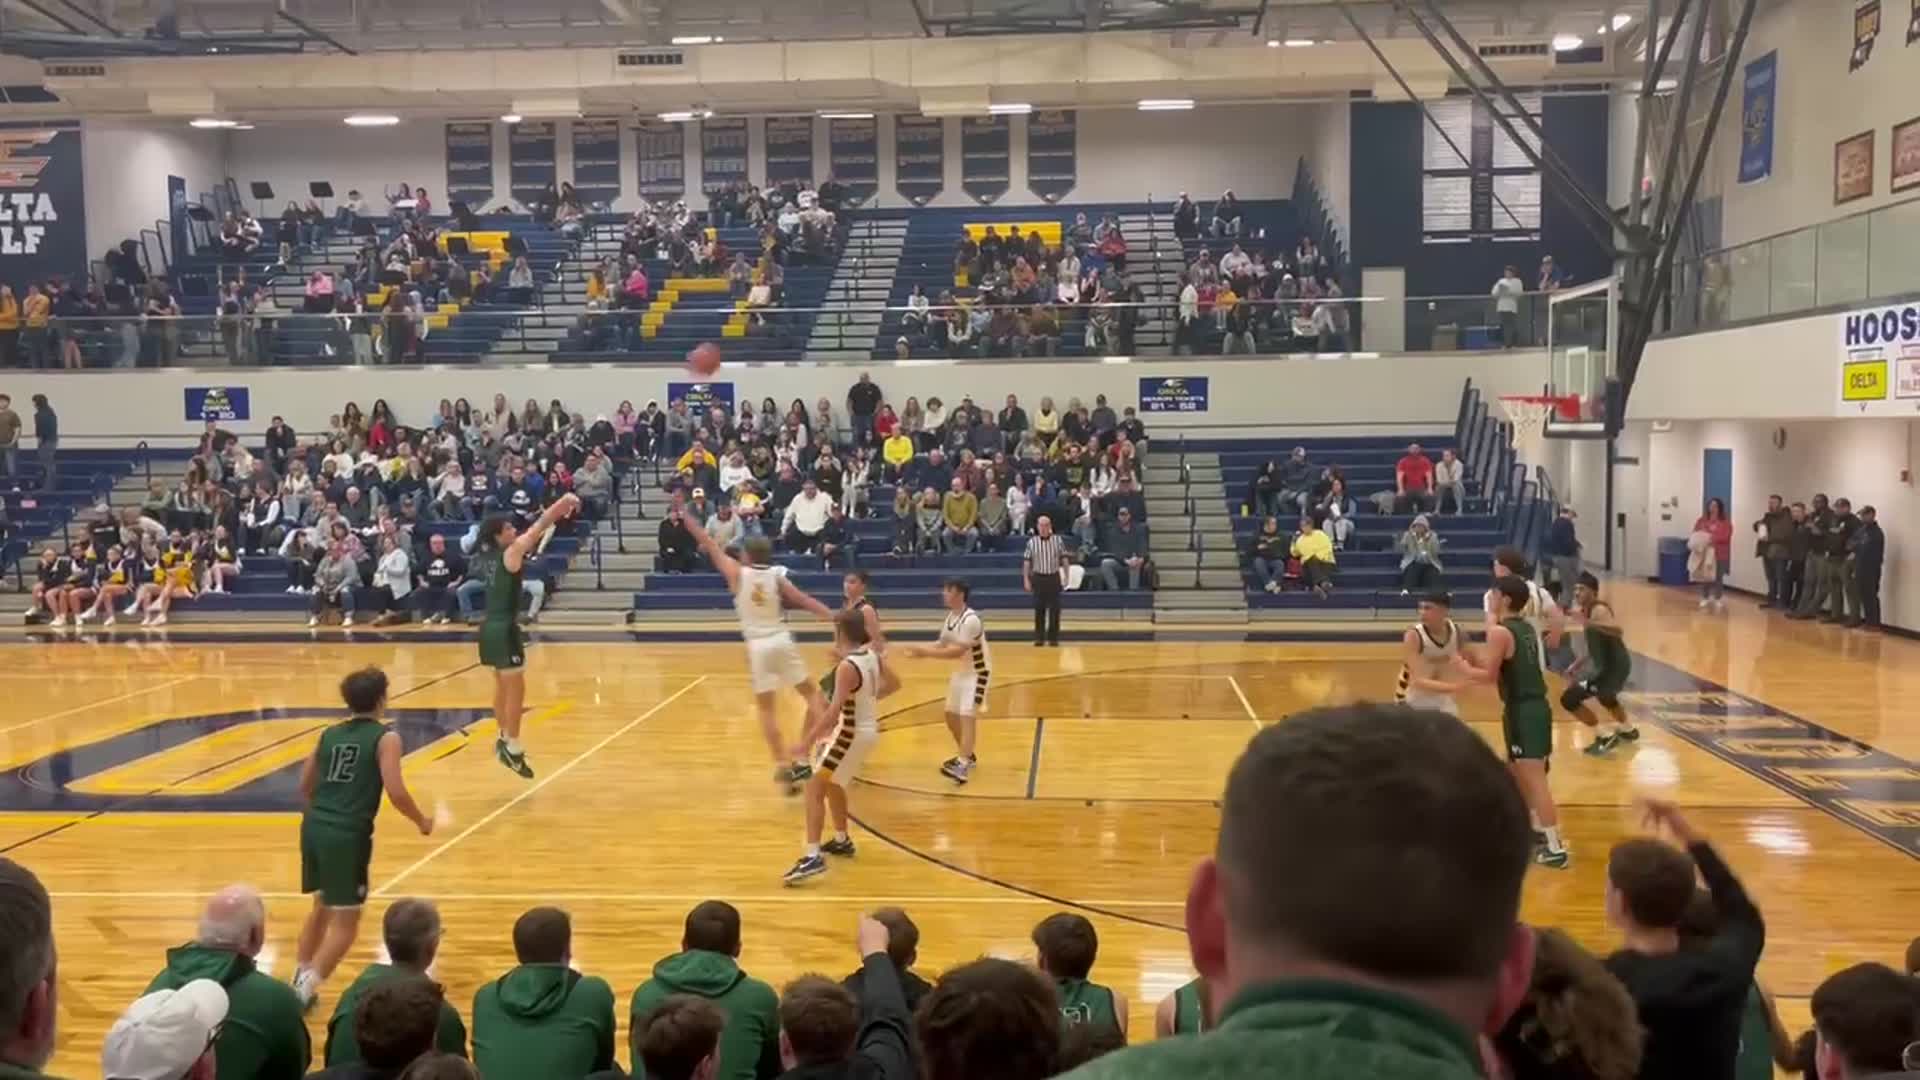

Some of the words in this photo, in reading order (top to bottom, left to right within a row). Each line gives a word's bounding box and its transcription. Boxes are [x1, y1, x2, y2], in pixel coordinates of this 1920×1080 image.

[1845, 307, 1920, 346] HOOS
[1850, 372, 1878, 389] DELTA
[327, 743, 361, 783] 12
